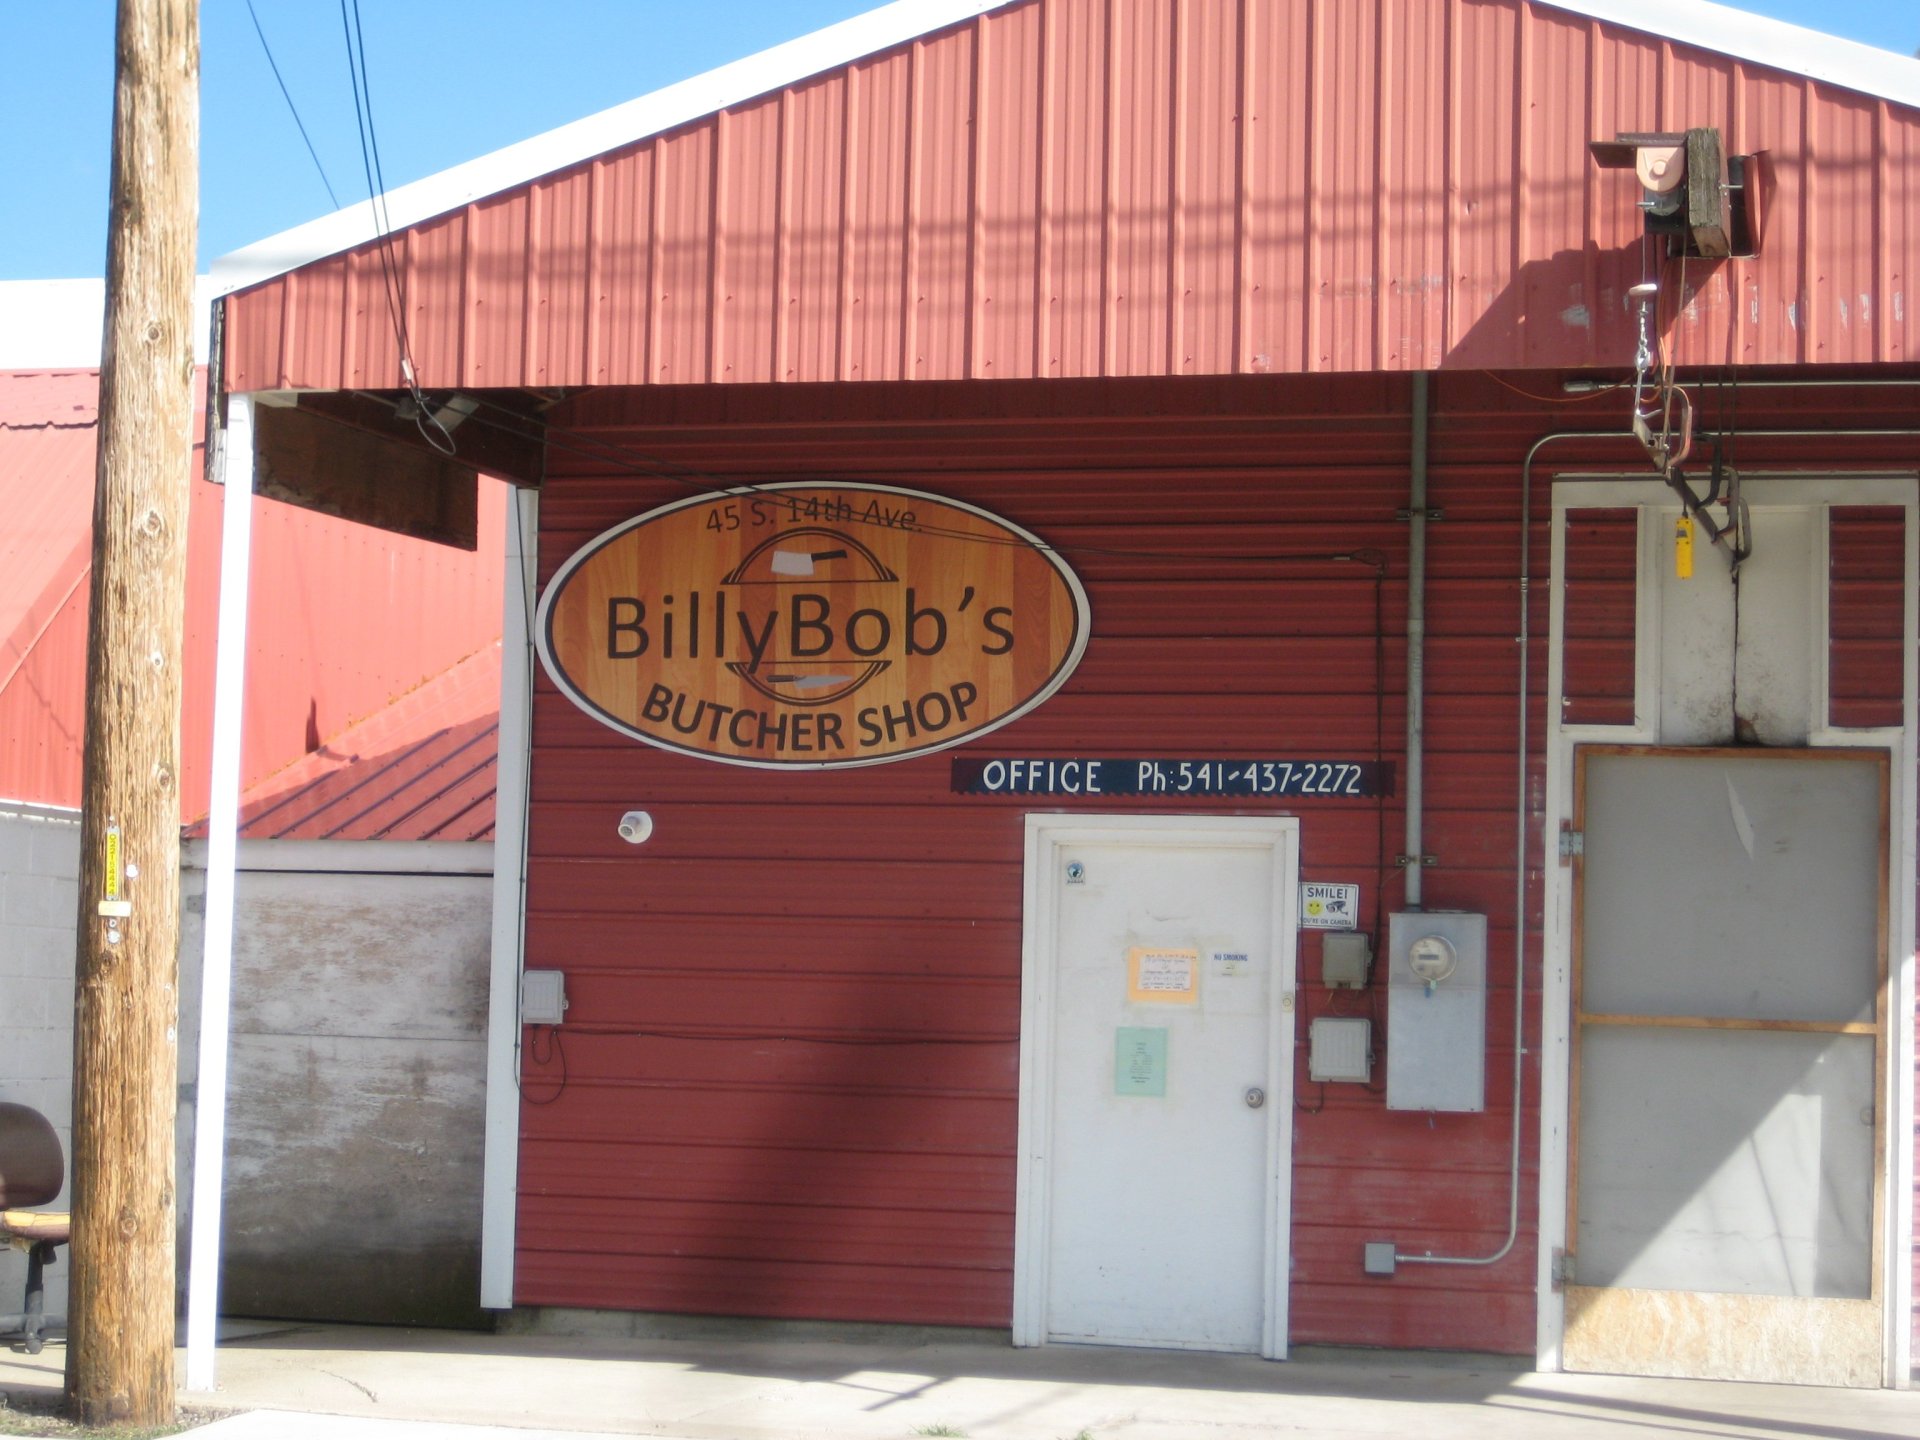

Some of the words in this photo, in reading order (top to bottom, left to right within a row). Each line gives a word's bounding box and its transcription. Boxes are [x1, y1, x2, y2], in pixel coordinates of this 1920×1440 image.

[706, 505, 740, 533] 45
[751, 500, 775, 526] S.
[787, 495, 852, 523] 14th
[862, 499, 922, 532] Ave.
[607, 586, 1015, 673] BillyBob's
[641, 683, 845, 751] BUTCHER
[859, 681, 978, 747] SHOP
[983, 760, 1101, 792] OFFICE
[1307, 887, 1348, 900] SMILE!
[1214, 953, 1222, 961] NO
[1223, 953, 1248, 962] SMOKING
